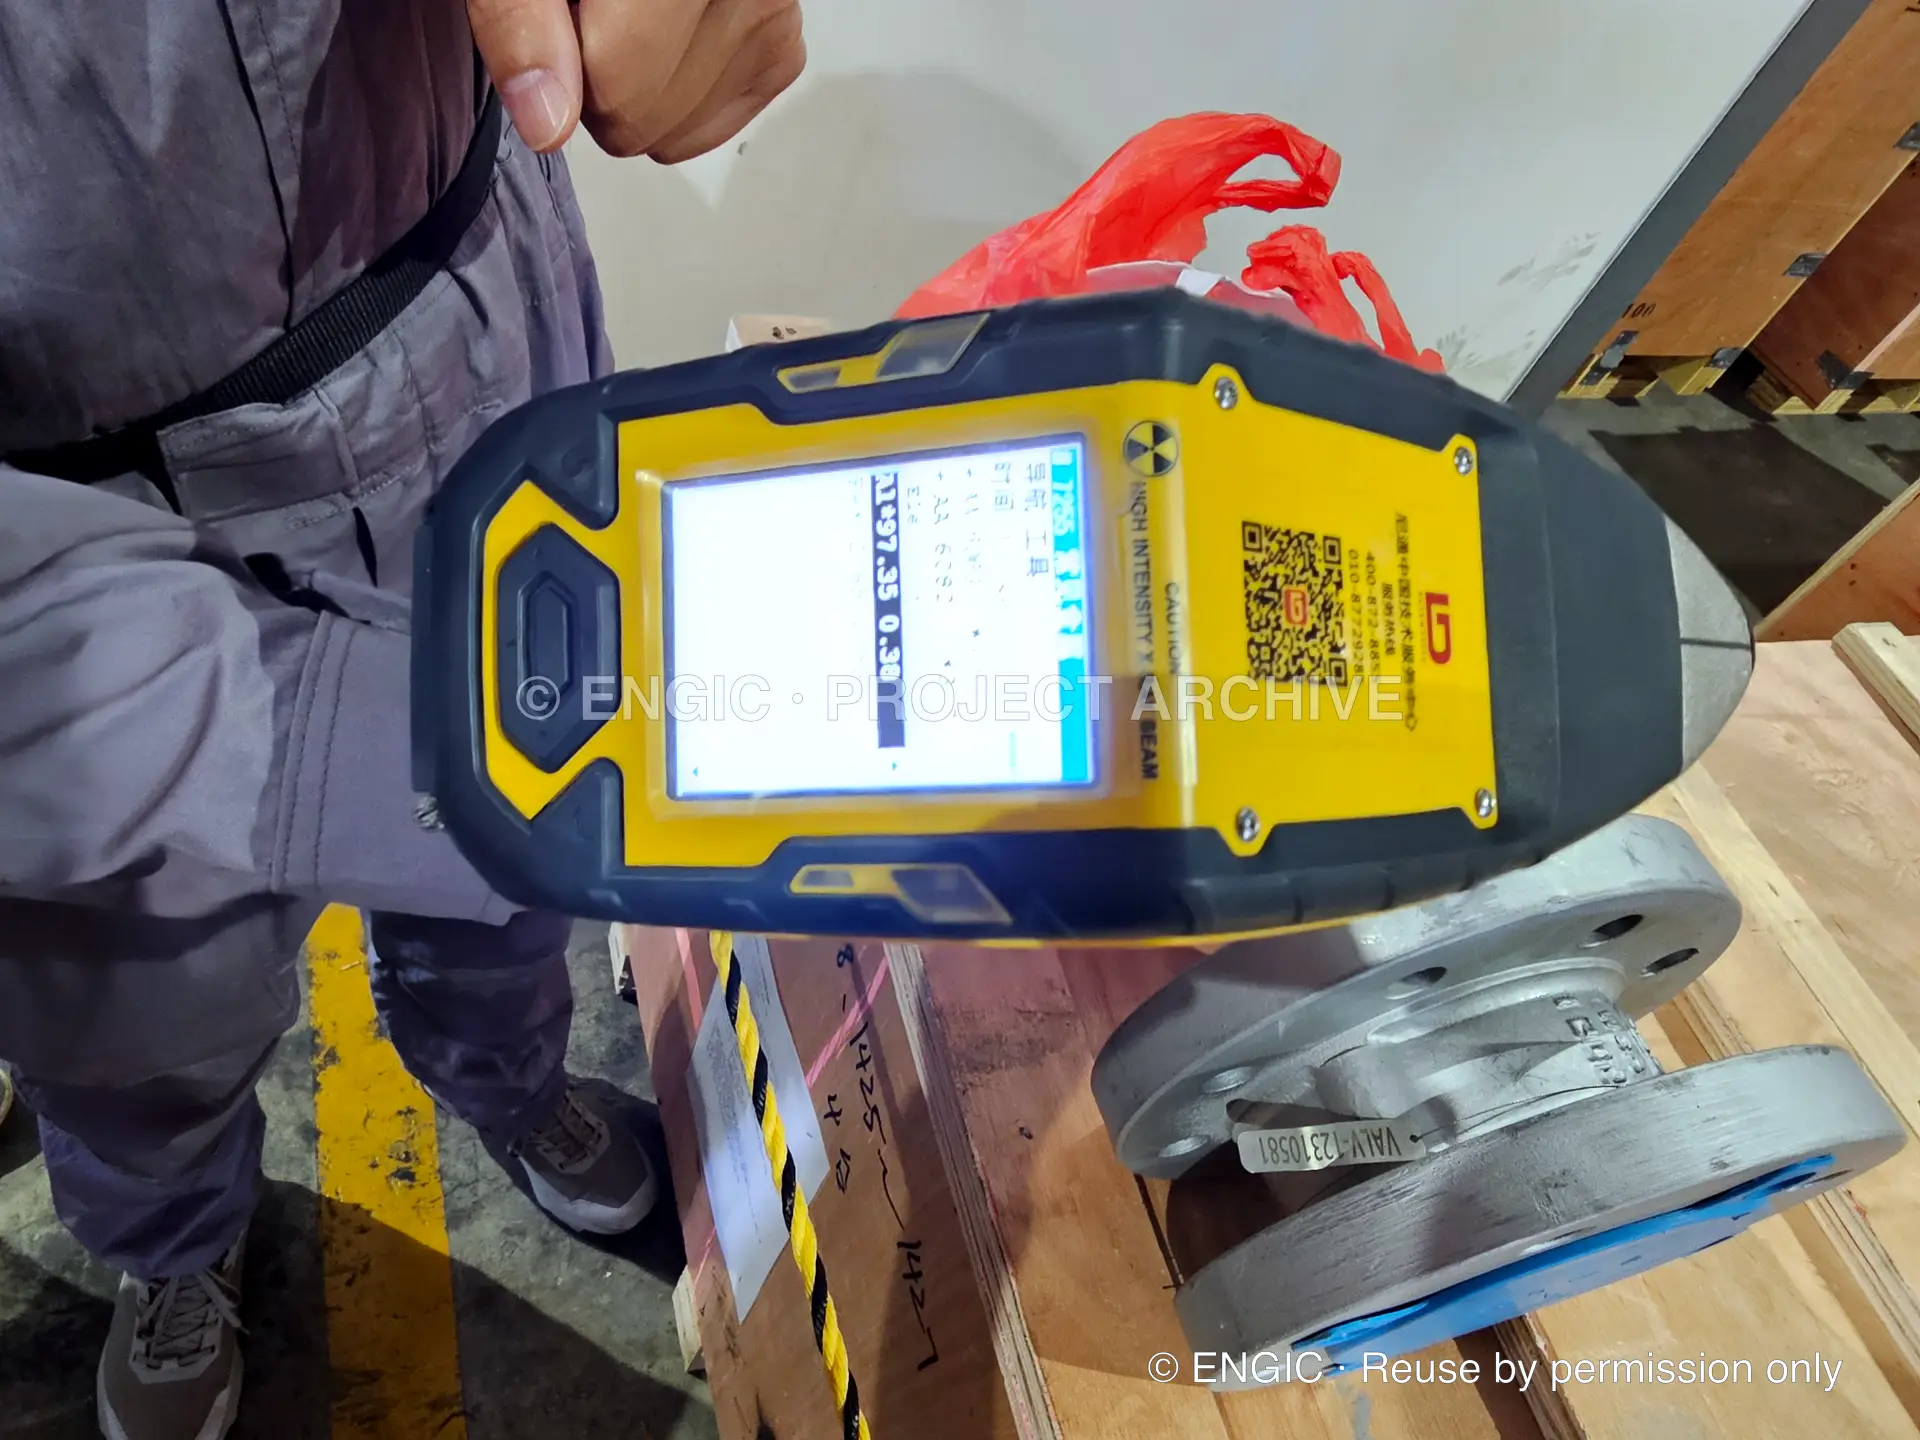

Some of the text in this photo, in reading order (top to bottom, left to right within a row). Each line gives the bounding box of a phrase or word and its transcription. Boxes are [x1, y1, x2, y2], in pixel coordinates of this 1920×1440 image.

[1025, 527, 1049, 579] 工具
[1132, 537, 1154, 645] INTENSITY
[1164, 581, 1182, 675] CAUTION
[1139, 719, 1160, 781] BEAM
[1257, 1126, 1402, 1166] VALV-12310581
